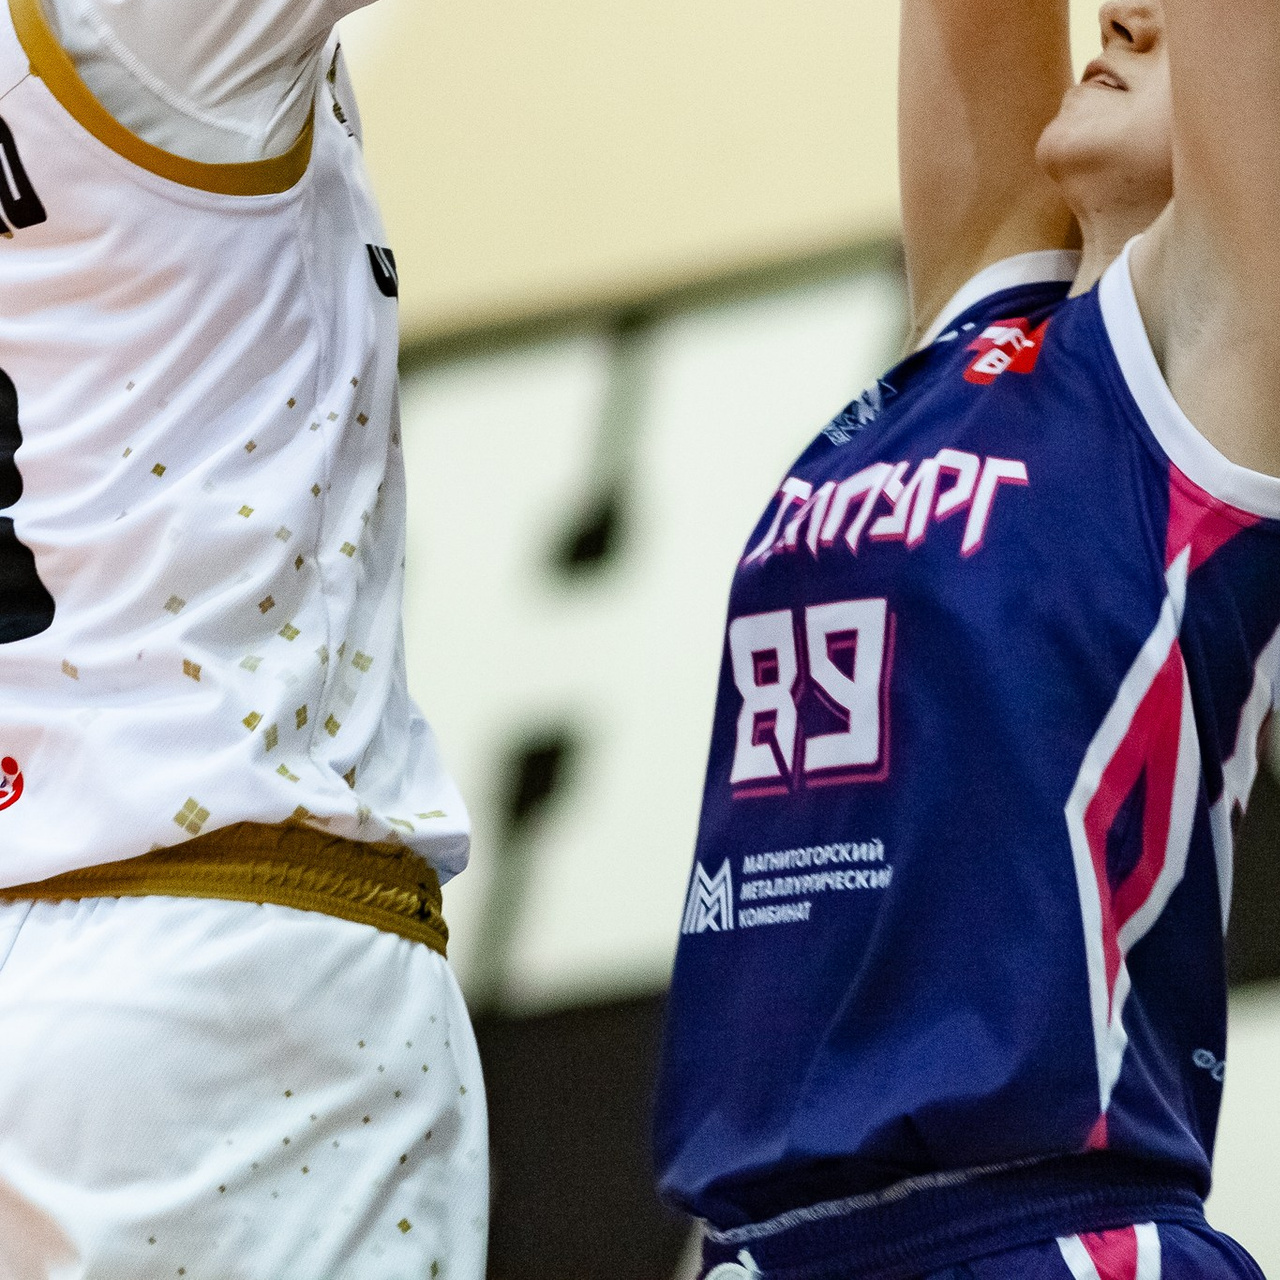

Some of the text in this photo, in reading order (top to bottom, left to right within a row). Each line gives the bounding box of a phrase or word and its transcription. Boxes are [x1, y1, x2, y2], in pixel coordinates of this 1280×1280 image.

[728, 596, 898, 798] 89
[742, 837, 885, 874] МАГНИТОГОРСКИЙ
[740, 863, 893, 901] МЕТАЛЛУРГИЧЕСКИЙ
[738, 900, 811, 928] КОМБИНАТ
